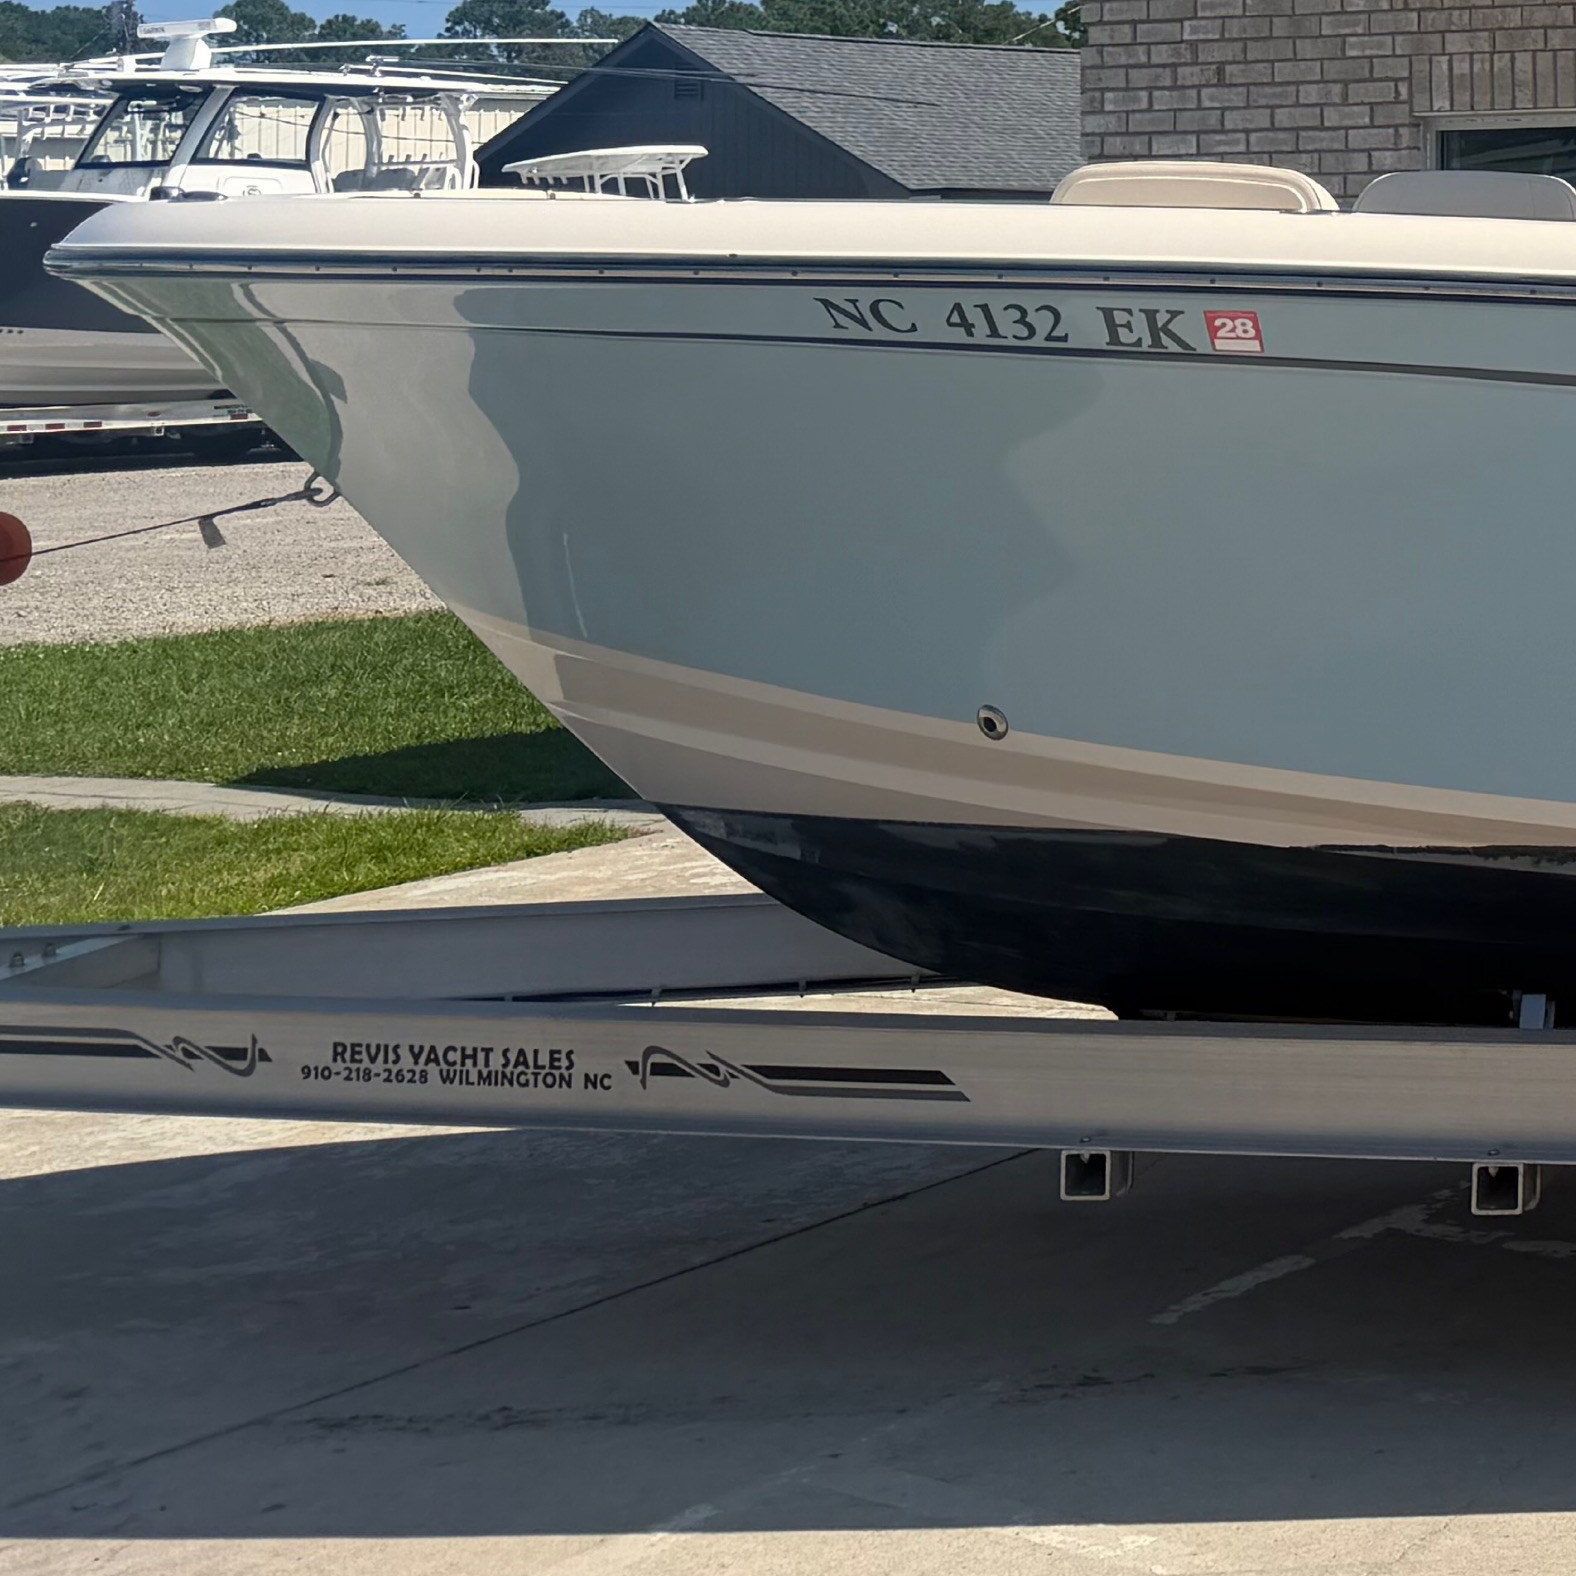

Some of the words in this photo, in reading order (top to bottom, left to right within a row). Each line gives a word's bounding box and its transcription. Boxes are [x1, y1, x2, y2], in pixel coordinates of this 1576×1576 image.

[813, 297, 918, 334] NC
[945, 302, 1070, 343] 4132
[1096, 306, 1197, 352] EK
[1214, 317, 1256, 338] 28
[331, 1041, 402, 1065] REVIS
[408, 1044, 494, 1068] YACHT
[501, 1047, 575, 1072] SALES
[300, 1064, 429, 1085] 910-218-2628
[439, 1068, 573, 1089] WILMINGTON
[583, 1072, 613, 1091] NC
